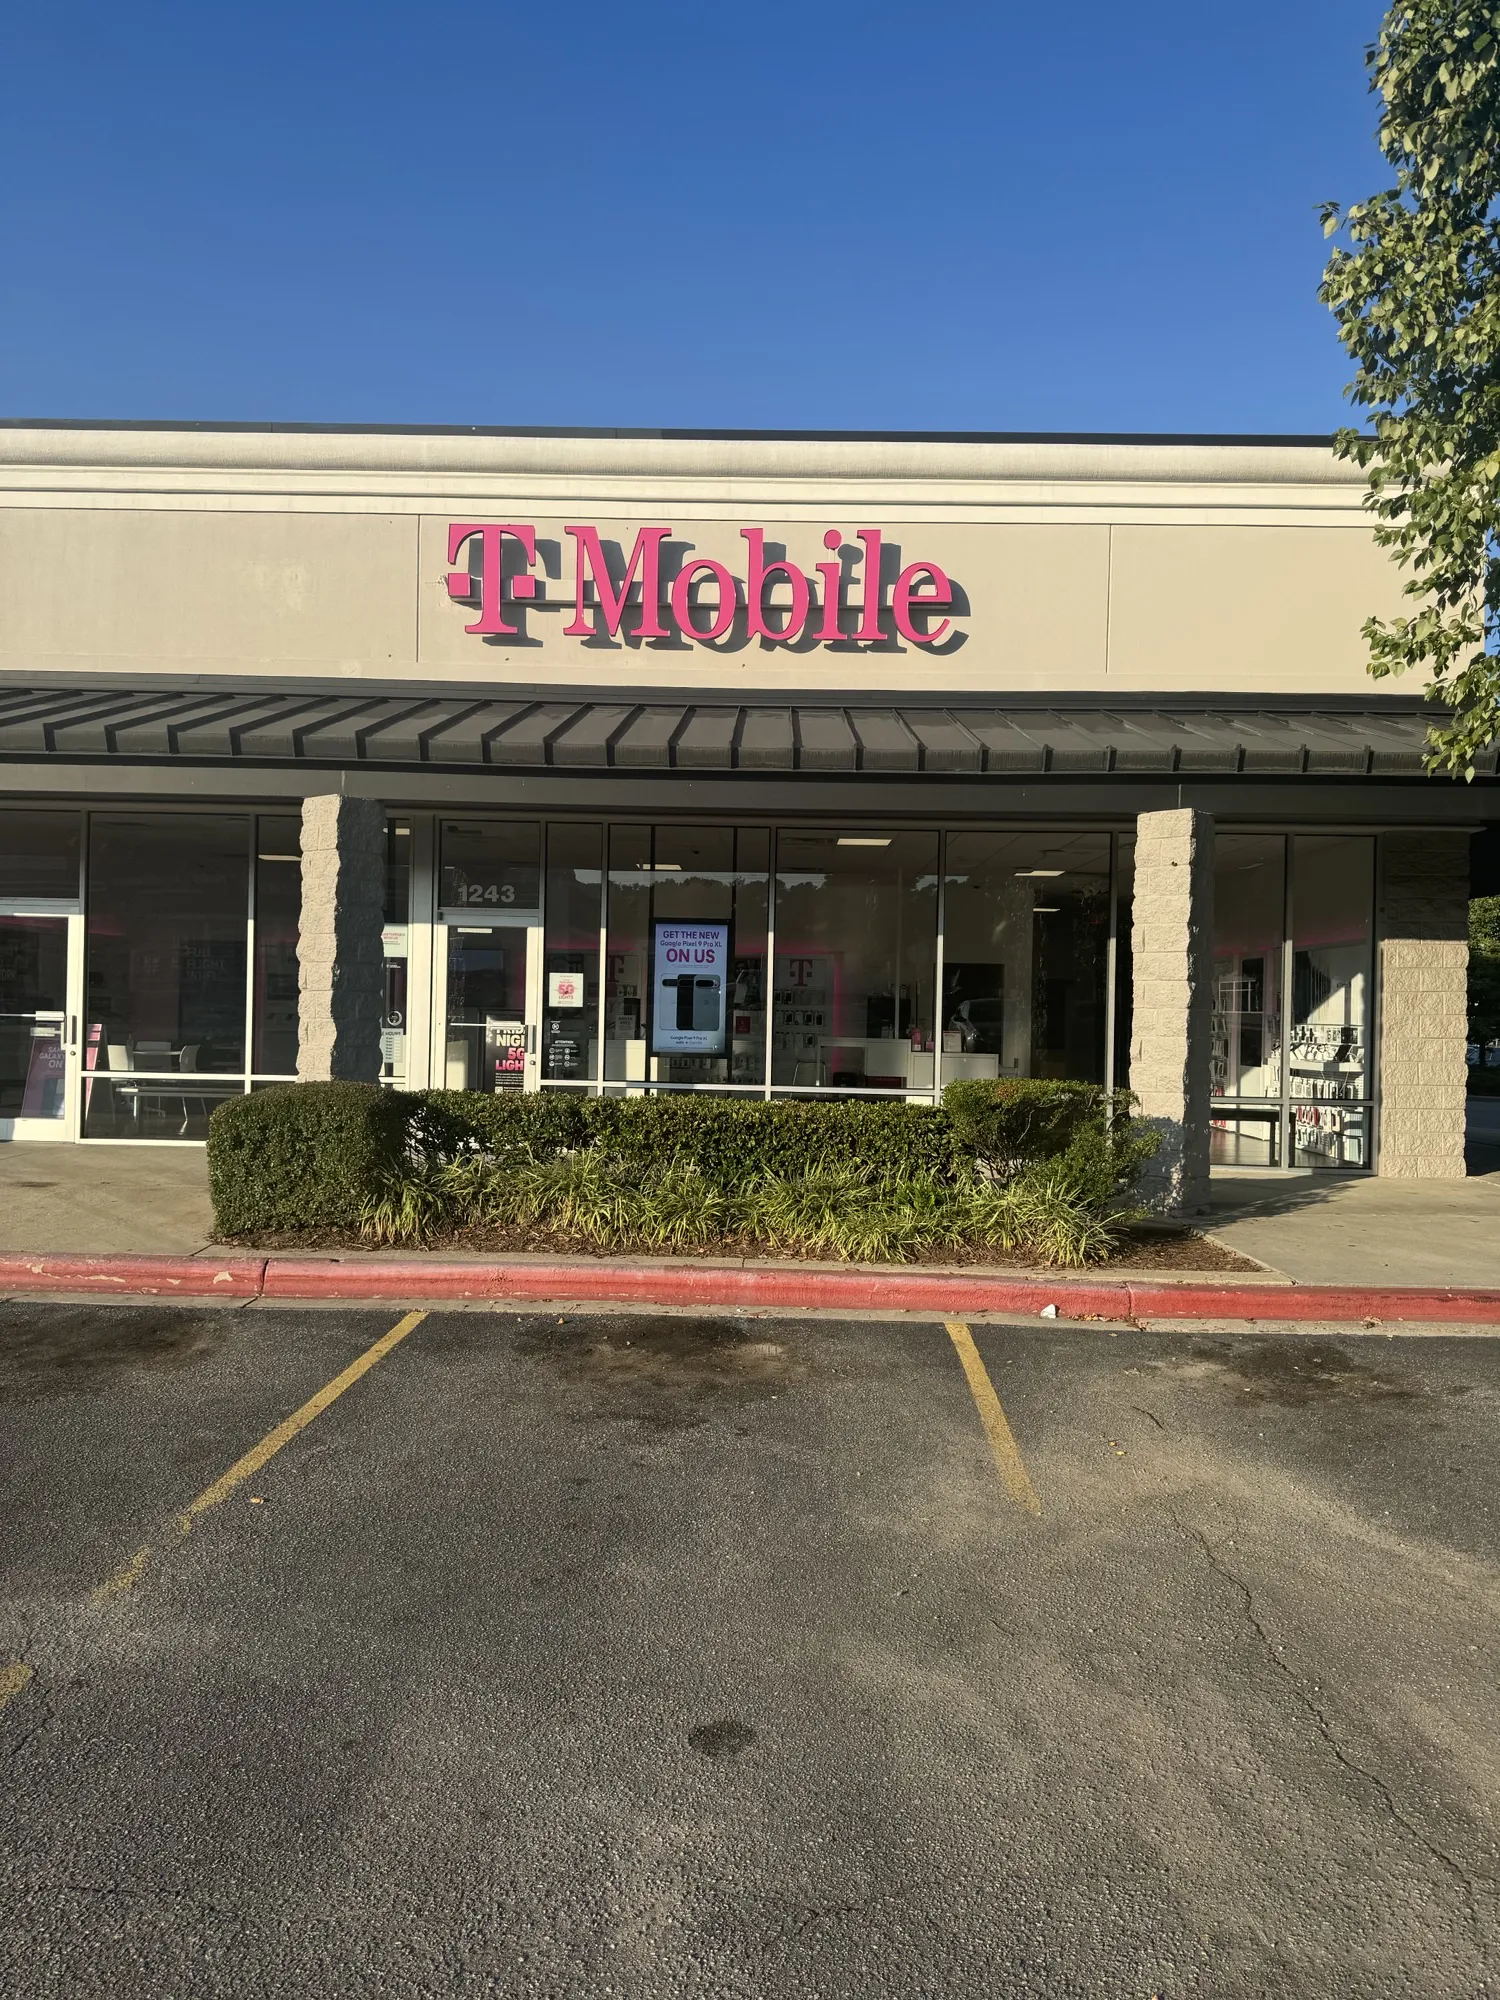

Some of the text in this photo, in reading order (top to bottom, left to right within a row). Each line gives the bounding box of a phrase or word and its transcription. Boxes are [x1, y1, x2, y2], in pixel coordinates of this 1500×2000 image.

[458, 884, 515, 902] 1243
[663, 931, 720, 940] GET THE NEW
[660, 940, 681, 948] Google
[666, 948, 716, 963] ON US
[558, 984, 574, 995] 5G
[508, 1047, 525, 1060] 5G
[496, 1059, 525, 1071] LIGH
